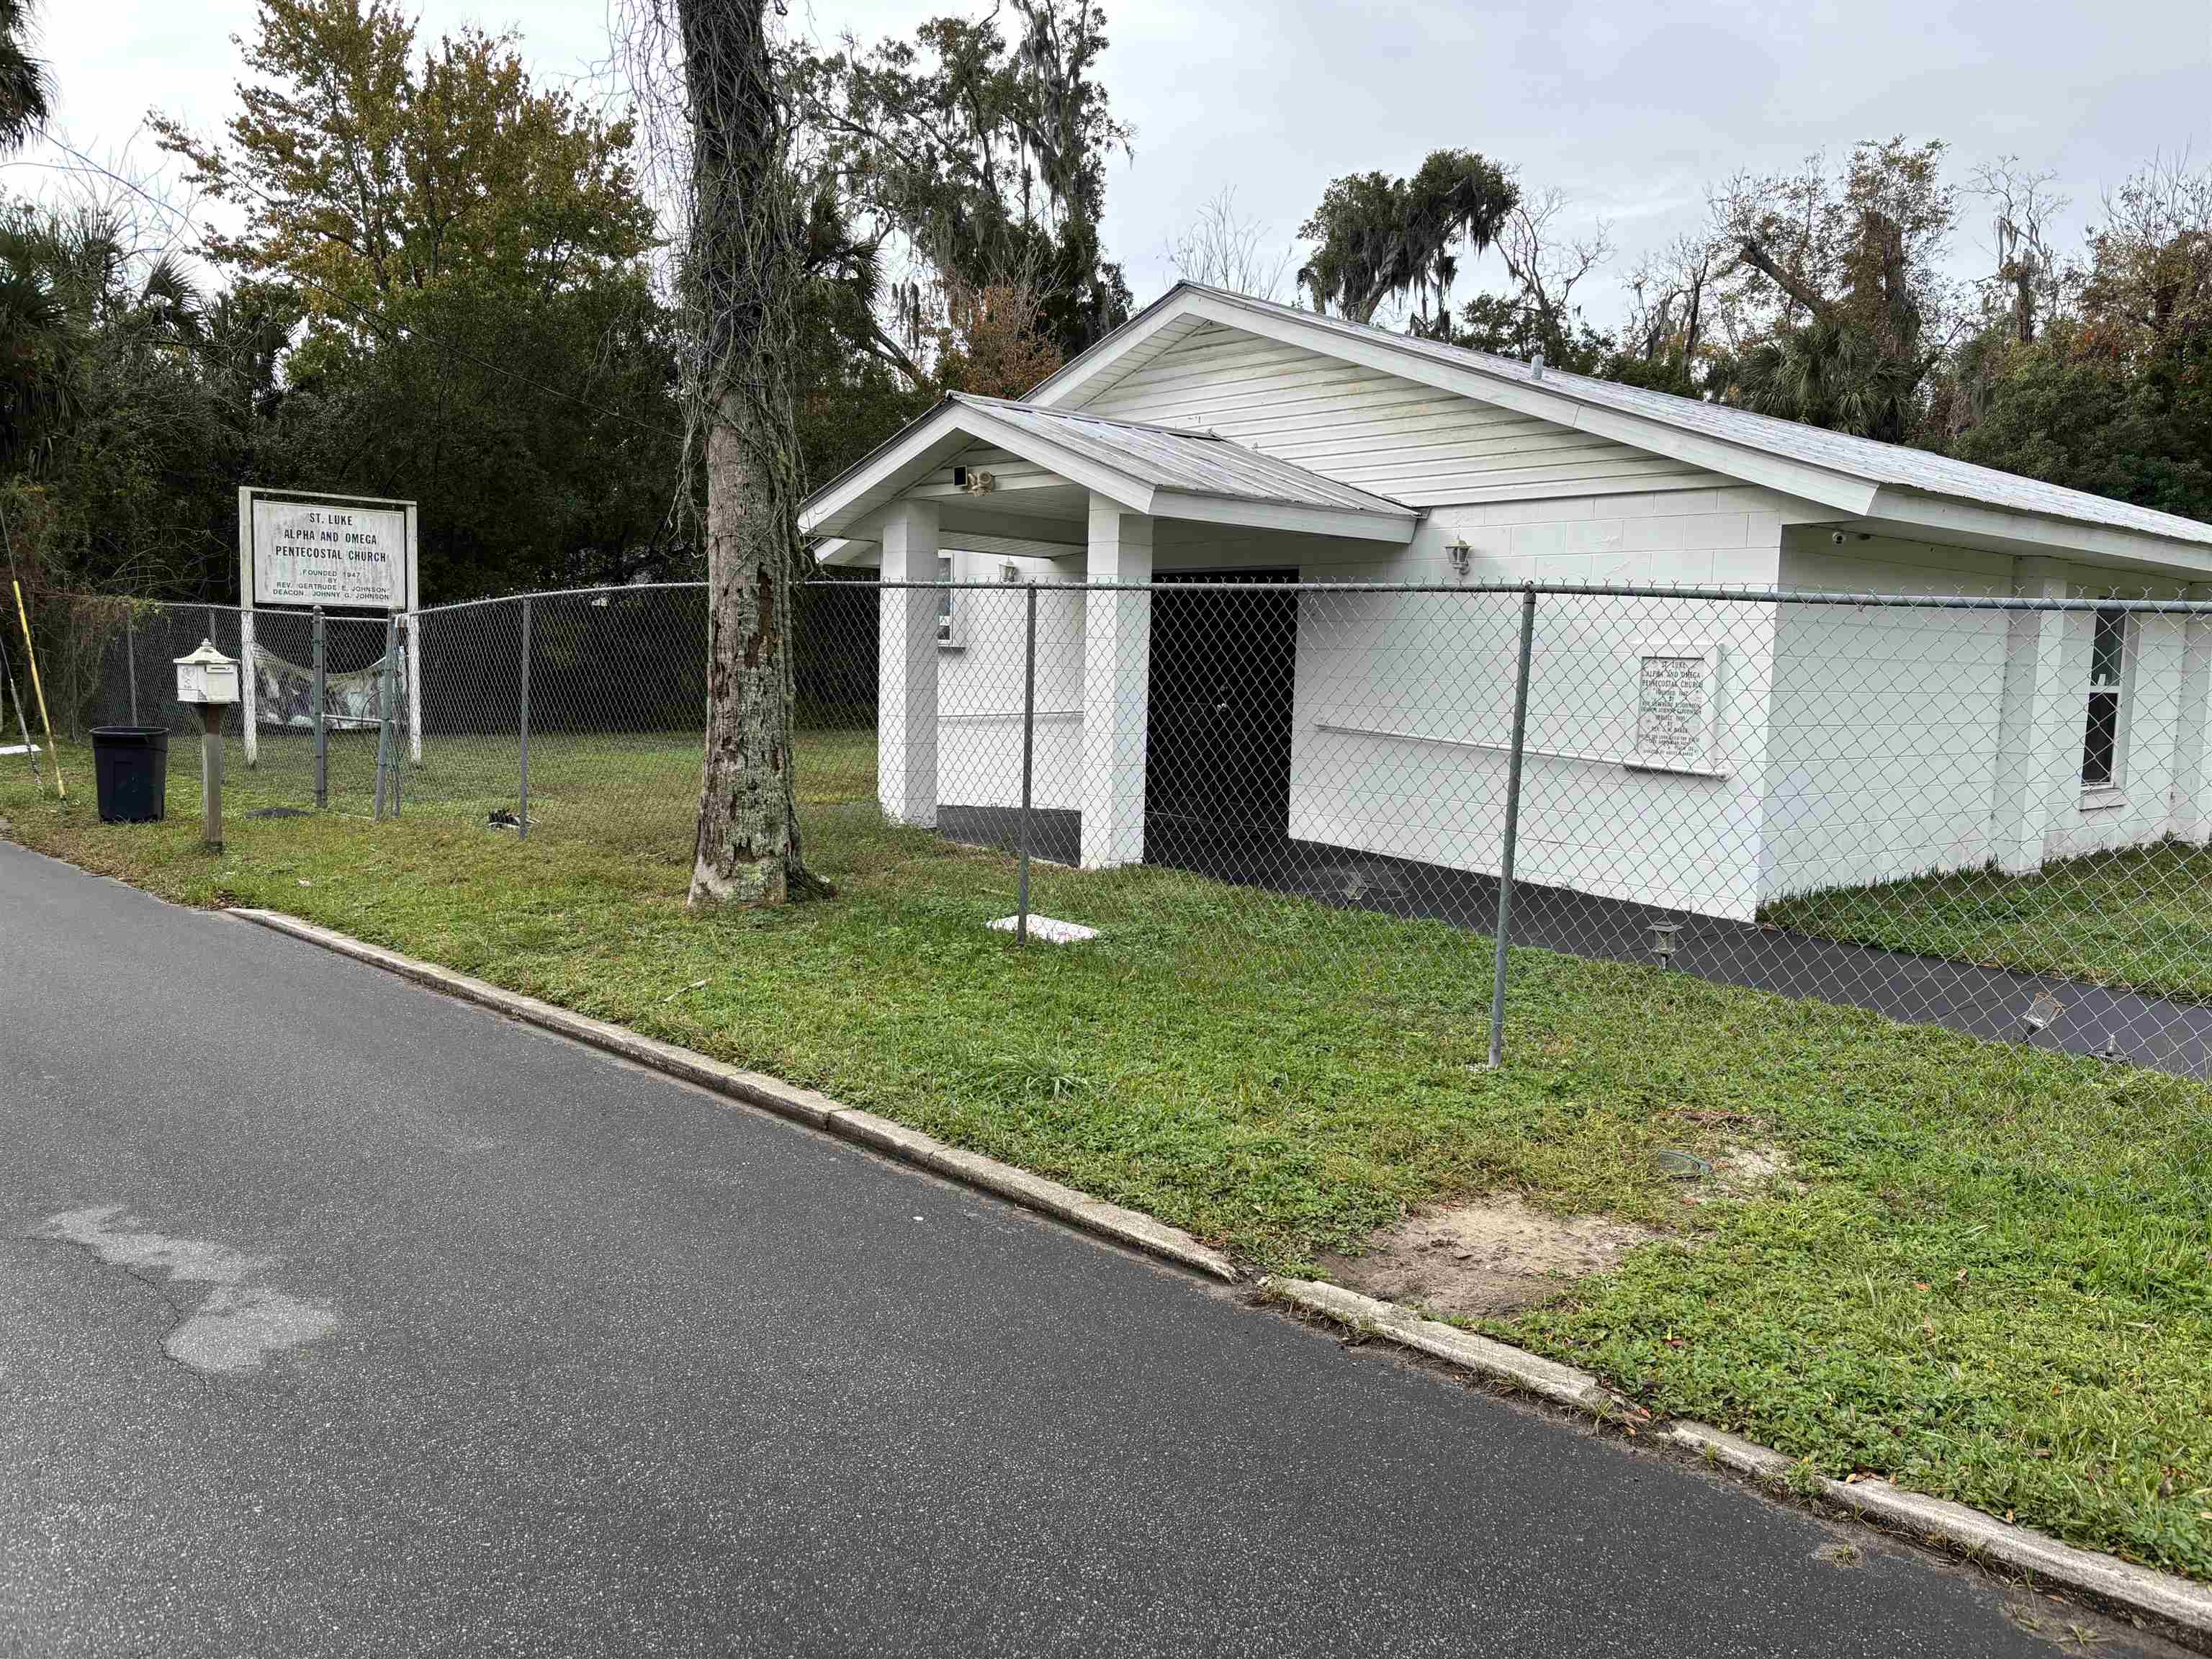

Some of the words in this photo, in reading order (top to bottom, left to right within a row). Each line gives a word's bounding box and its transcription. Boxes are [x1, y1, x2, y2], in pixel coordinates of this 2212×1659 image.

[310, 513, 324, 523] ST.
[328, 514, 353, 526] LUKE
[284, 529, 315, 541] ALPHA
[320, 531, 338, 542] AND
[346, 533, 377, 544] OMEGA
[276, 546, 342, 559] PENTECOSTAL
[349, 550, 386, 562] CHURCH
